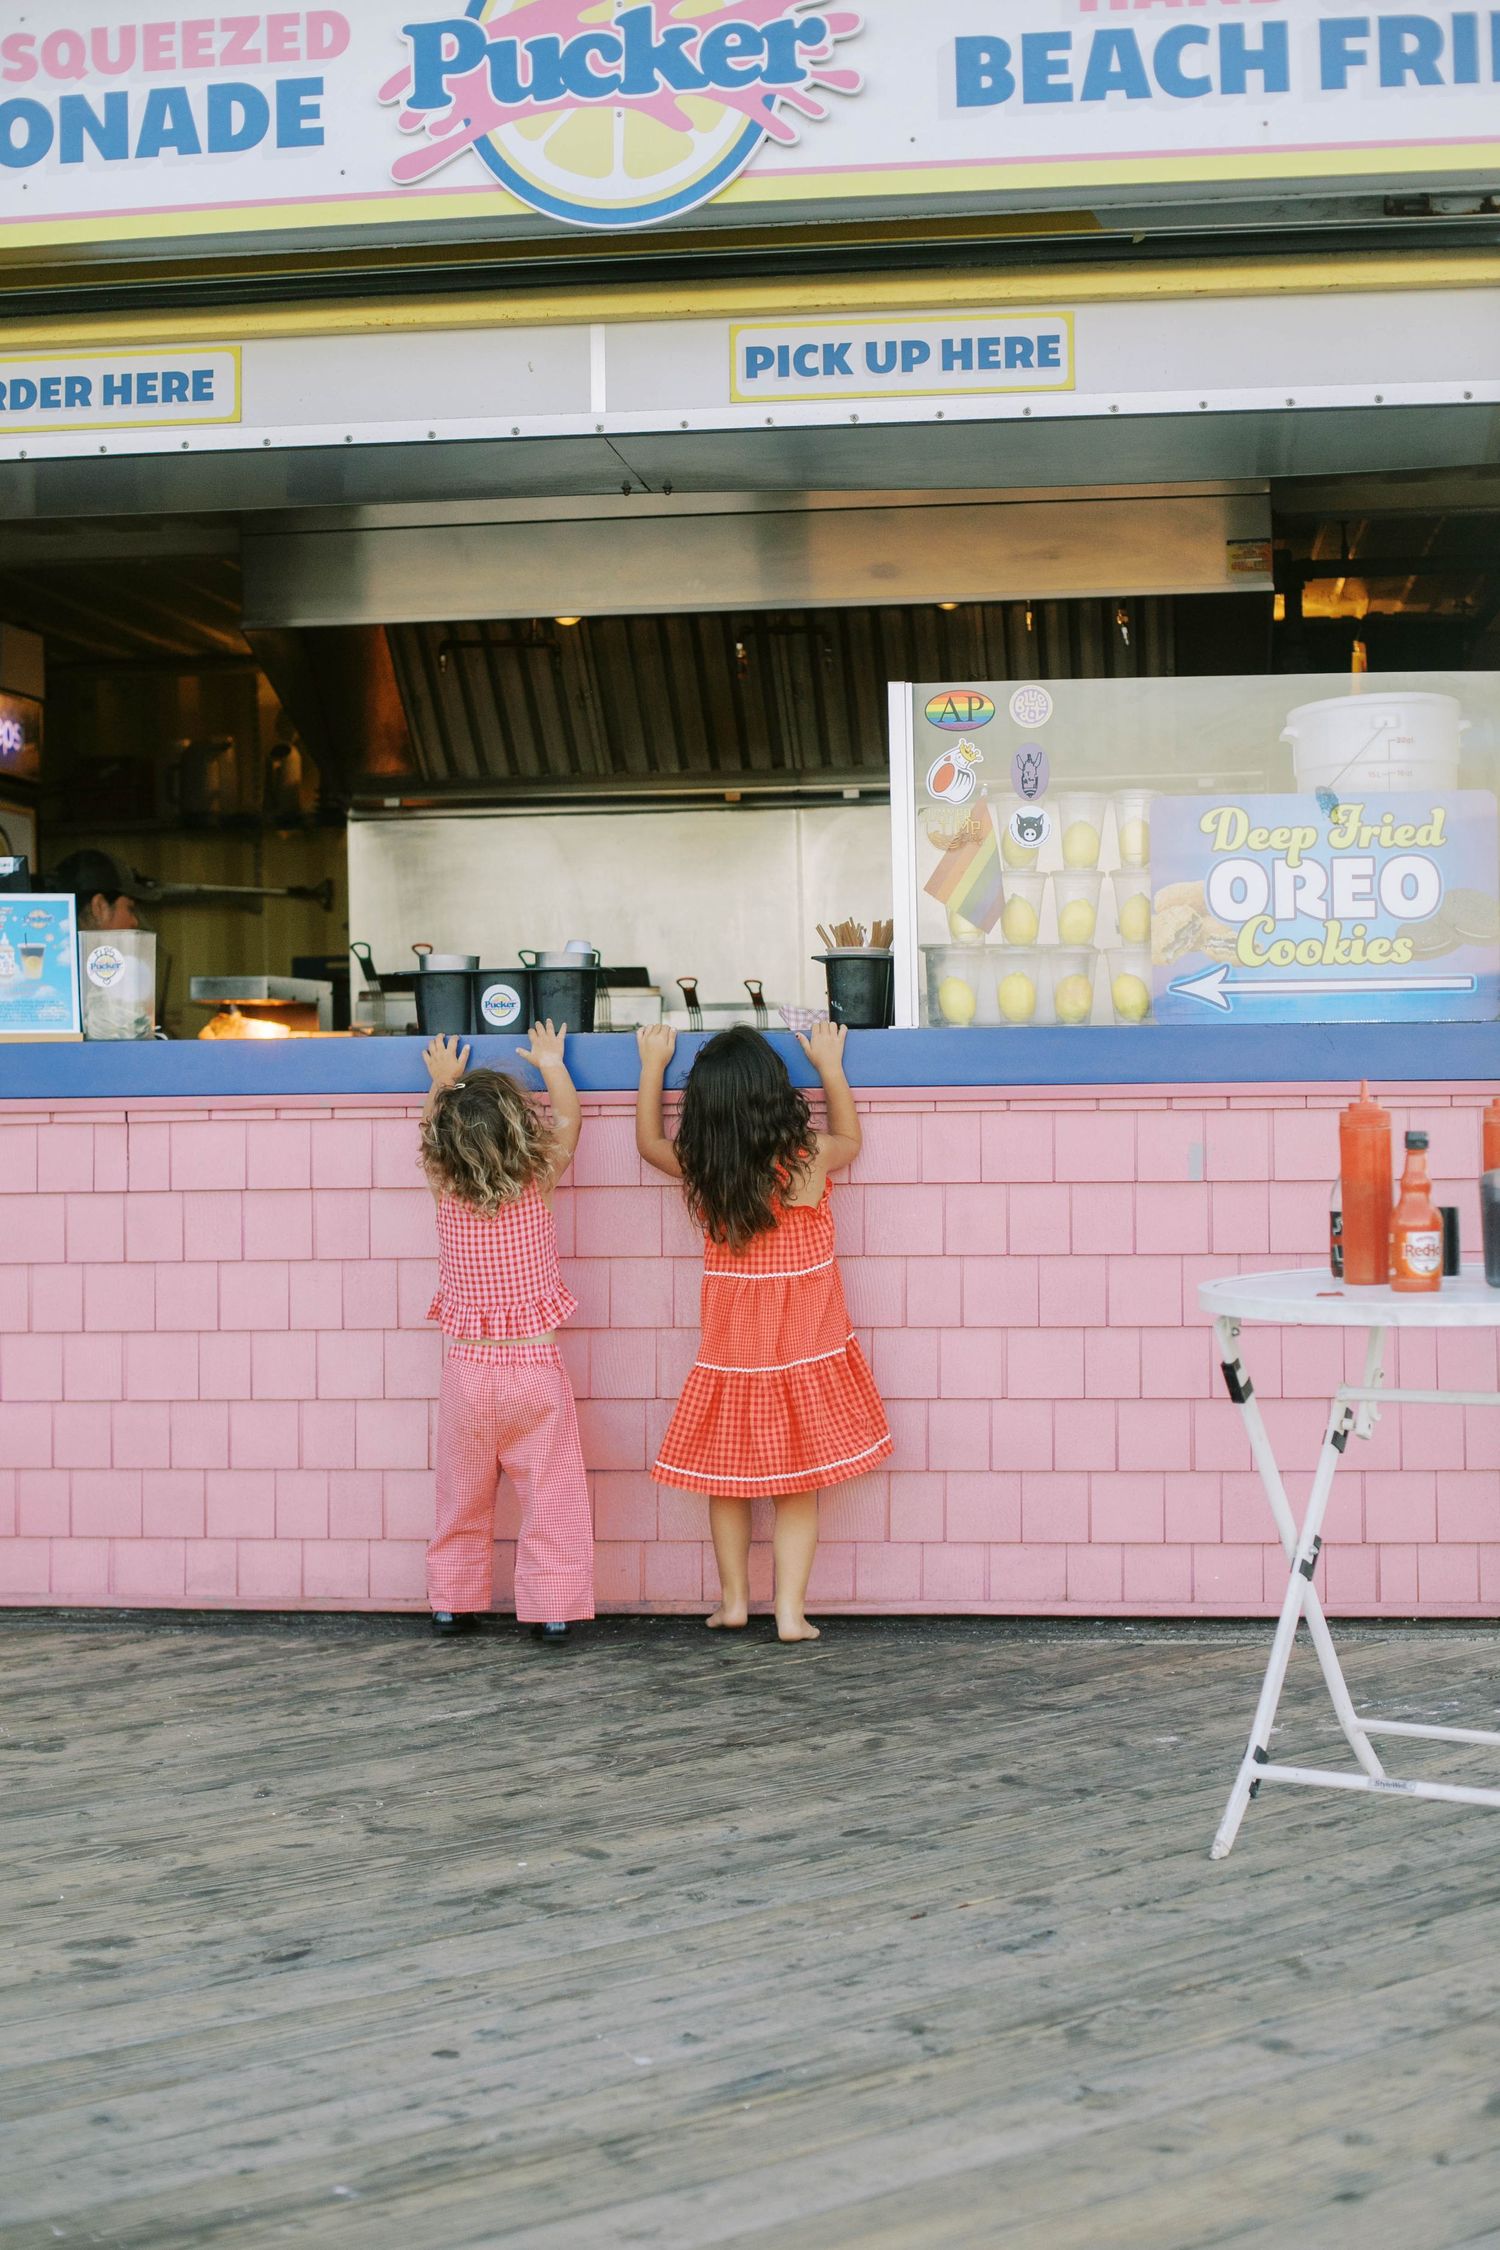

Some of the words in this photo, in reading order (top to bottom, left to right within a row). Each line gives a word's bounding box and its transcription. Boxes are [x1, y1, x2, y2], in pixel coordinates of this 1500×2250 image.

[1, 9, 351, 83] SQUEEZED
[402, 4, 827, 110] Pucker
[955, 20, 1289, 108] BEACH
[0, 76, 325, 168] ONADE
[745, 342, 854, 379] PICK
[865, 339, 931, 374] UP
[941, 334, 1061, 372] HERE
[0, 376, 92, 411] DER
[102, 368, 215, 406] HERE
[937, 696, 985, 723] AP
[1200, 806, 1318, 868] Deep
[1328, 803, 1447, 849] Fried
[1207, 854, 1442, 923] OREO
[1236, 914, 1415, 968] Cookies
[484, 1000, 517, 1009] Pucker
